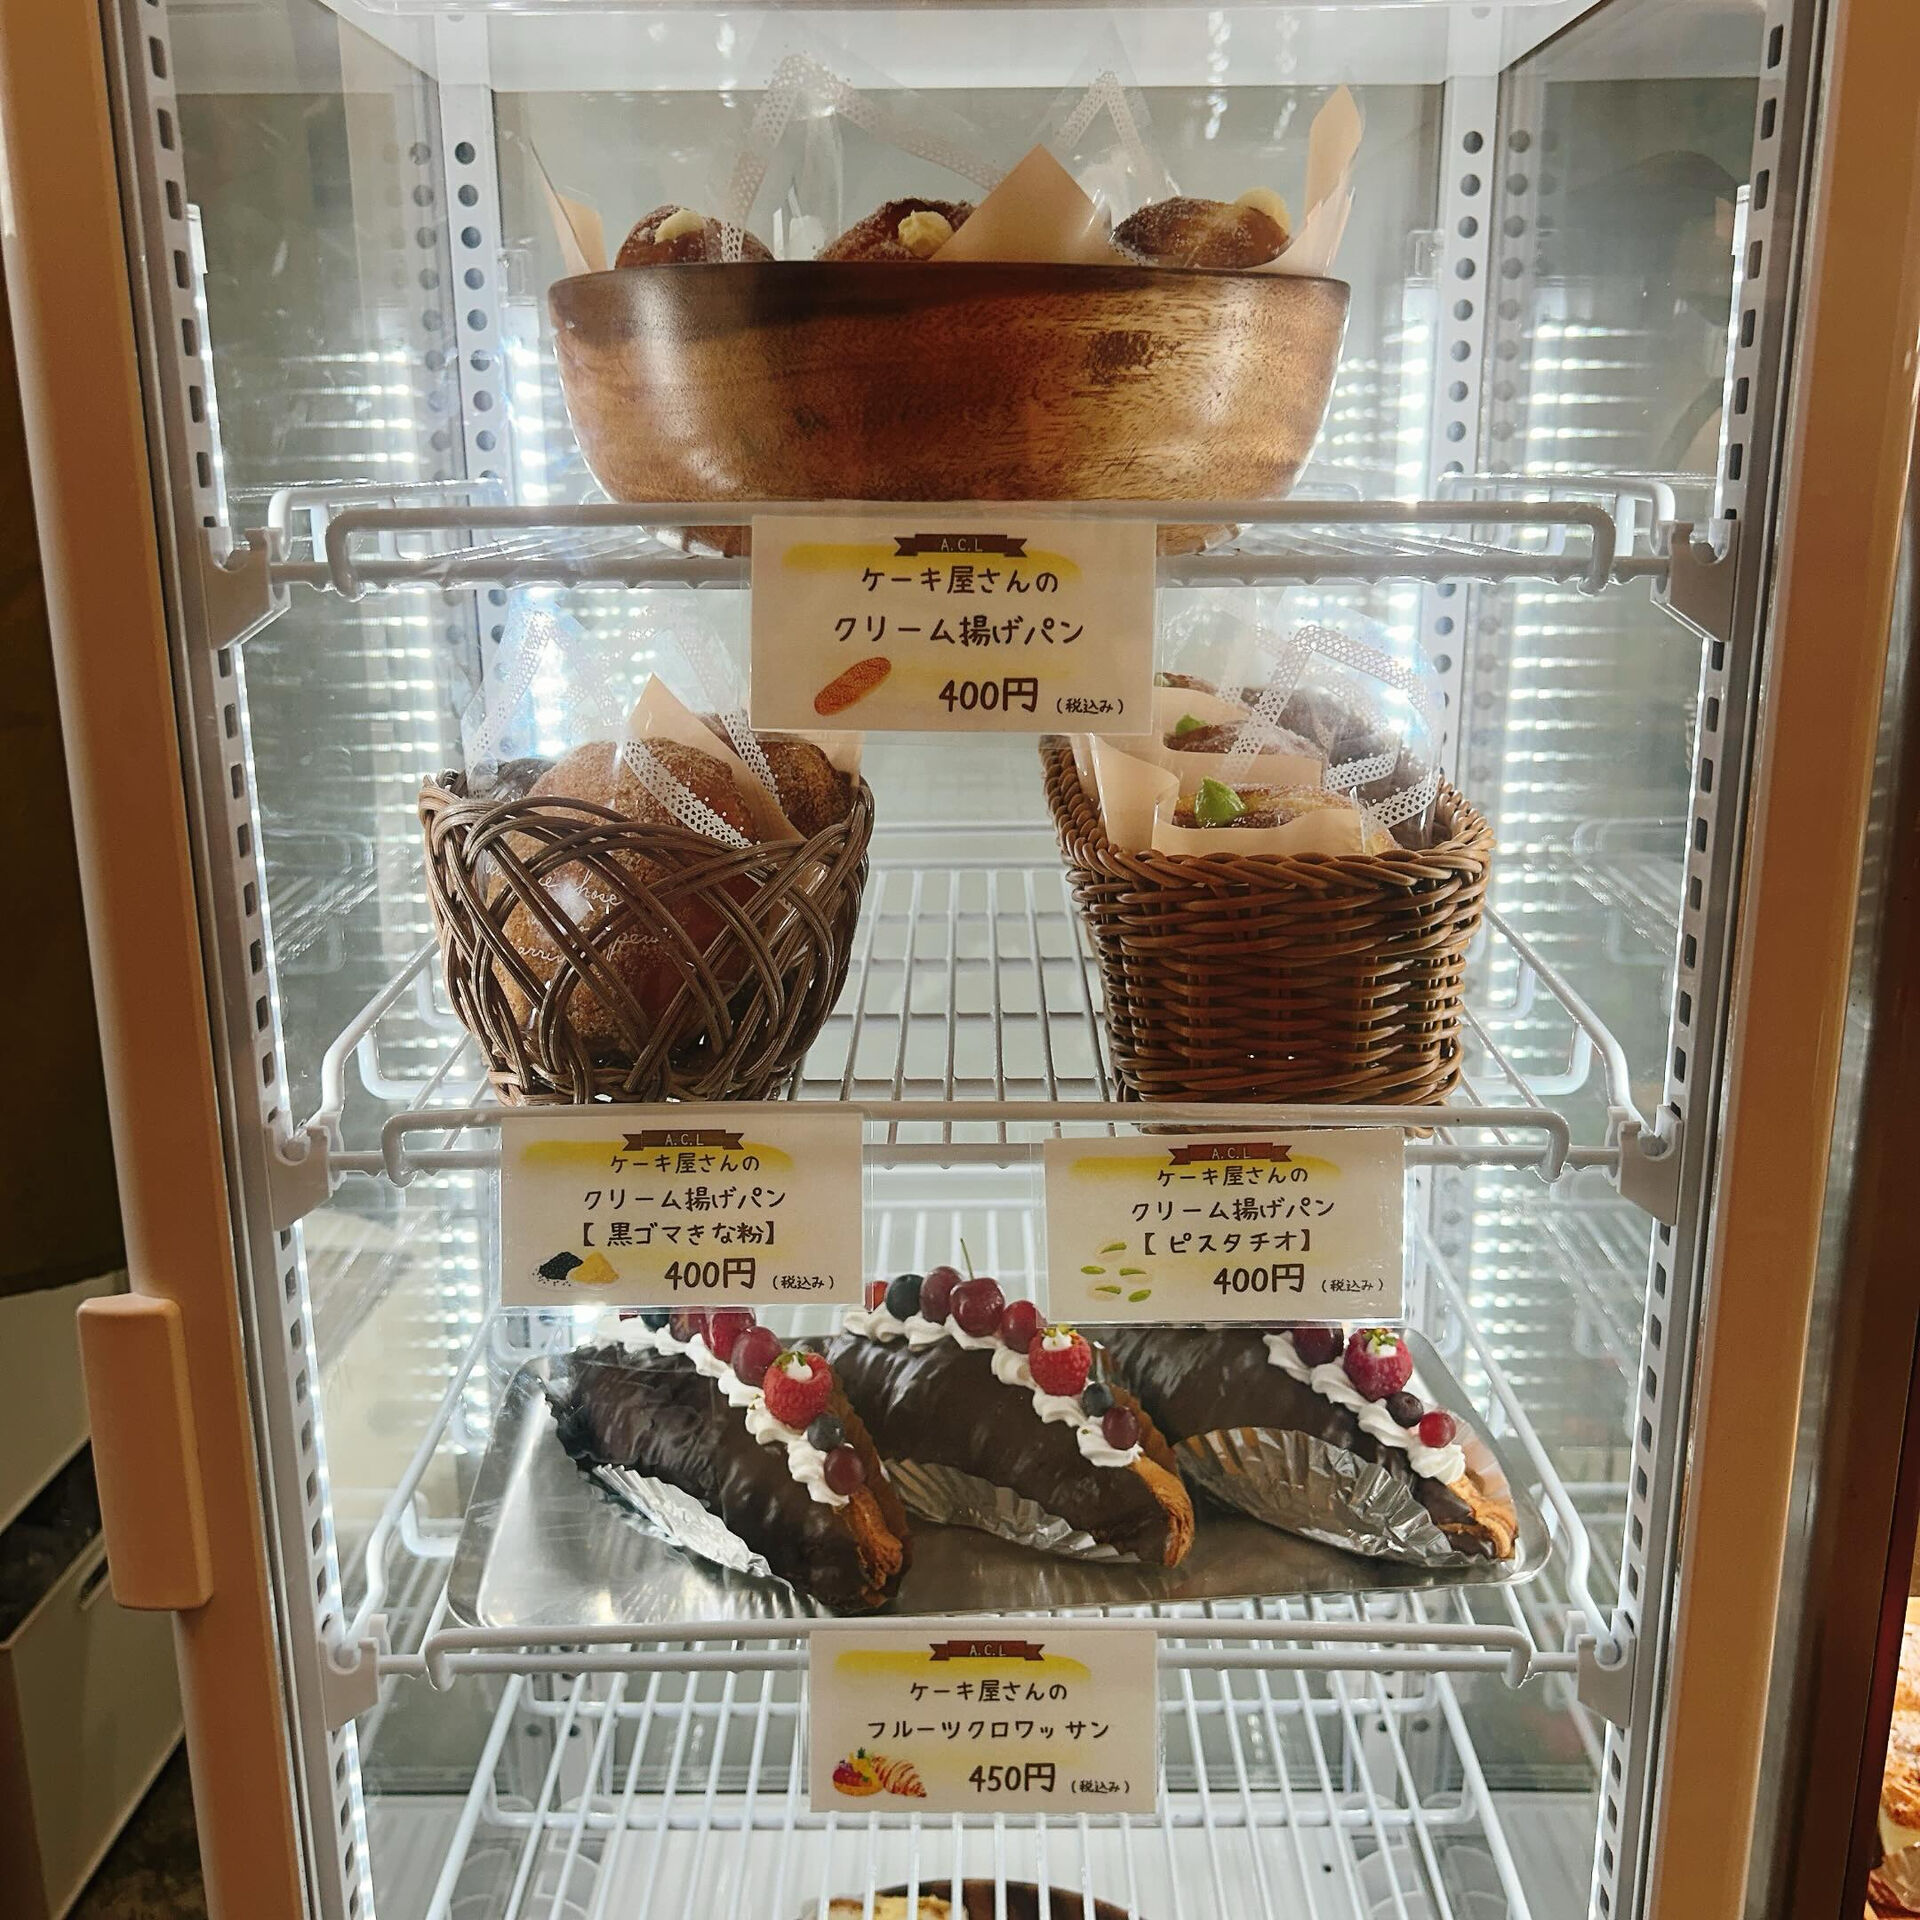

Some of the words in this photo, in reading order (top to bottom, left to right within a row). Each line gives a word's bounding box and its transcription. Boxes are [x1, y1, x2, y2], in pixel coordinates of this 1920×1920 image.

[861, 565, 1059, 594] ケーキ屋さんの
[834, 614, 1084, 648] クリーム揚げパン
[938, 677, 1039, 713] 400円
[1056, 697, 1124, 715] （税込み）
[610, 1152, 760, 1174] ケーキ屋さんの
[1157, 1165, 1309, 1187] ケーキ屋さんの
[584, 1185, 786, 1213] クリーム揚げパン
[1131, 1196, 1335, 1222] クリーム揚げパン
[664, 1257, 756, 1291] 400円
[772, 1274, 834, 1291] （税込み）
[1212, 1263, 1305, 1295] 400円
[1321, 1278, 1384, 1294] （税込み）
[909, 1679, 1068, 1702] ケーキ屋さんの
[867, 1720, 1109, 1740] フルーツクロワッサン
[968, 1762, 1056, 1793] 450円
[1071, 1779, 1131, 1794] （税込み）
